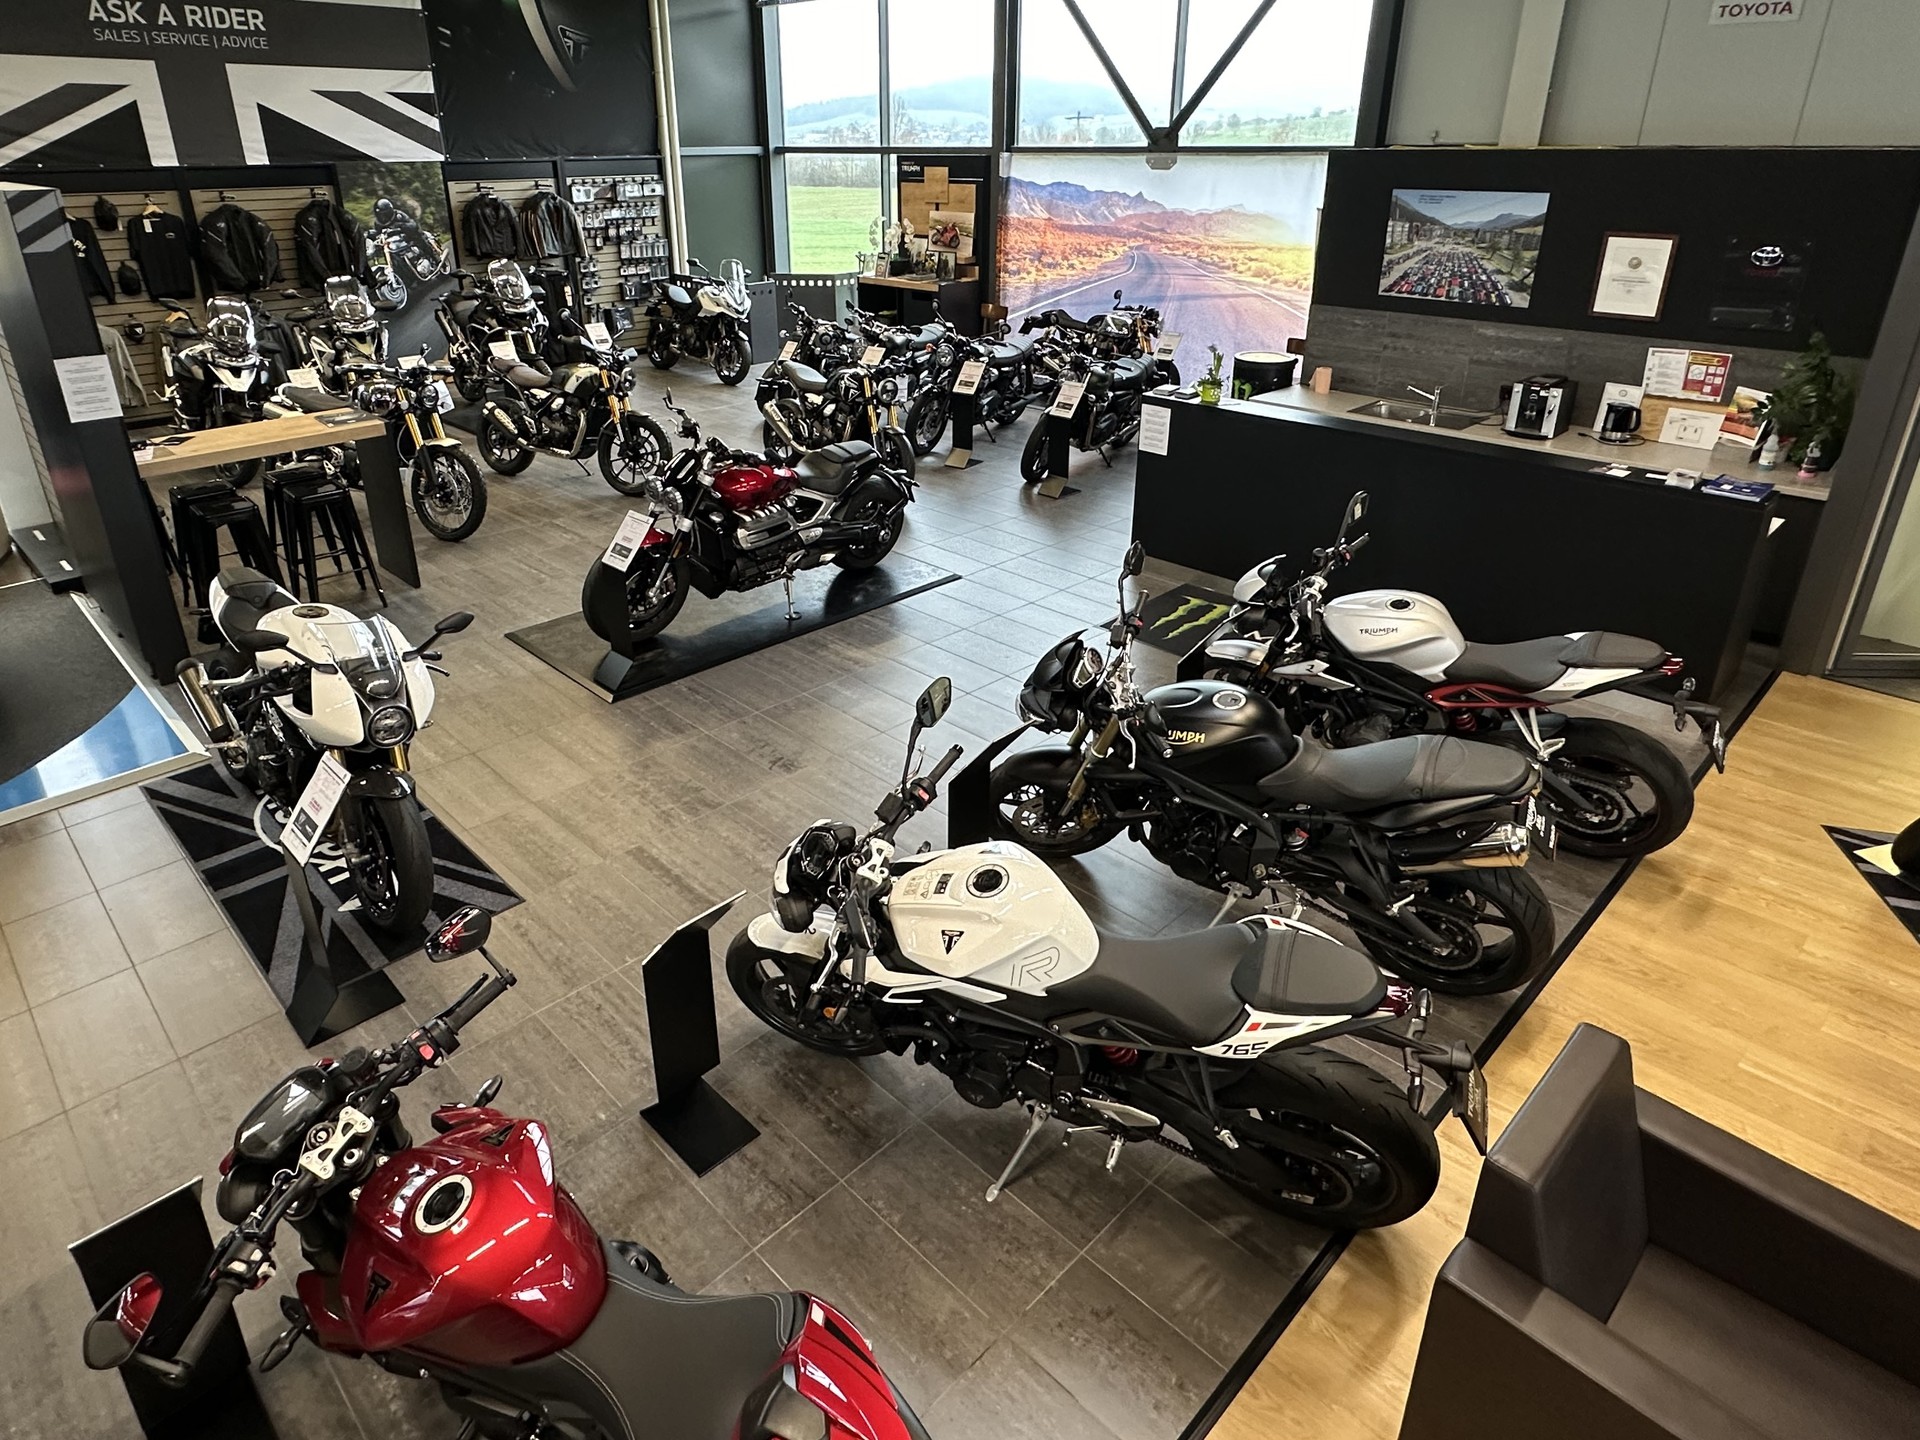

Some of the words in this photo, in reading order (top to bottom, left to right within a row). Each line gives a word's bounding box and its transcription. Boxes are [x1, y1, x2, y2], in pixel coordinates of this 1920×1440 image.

[88, 0, 147, 24] ASK
[157, 3, 177, 26] A
[183, 4, 266, 31] RIDER
[1719, 1, 1792, 18] TOYOTA
[93, 28, 141, 43] SALES
[151, 31, 210, 47] SERVICE
[221, 35, 269, 49] ADVICE
[1359, 627, 1398, 636] TRIUMPH
[1166, 729, 1206, 745] UMPH
[1220, 1040, 1269, 1056] 765
